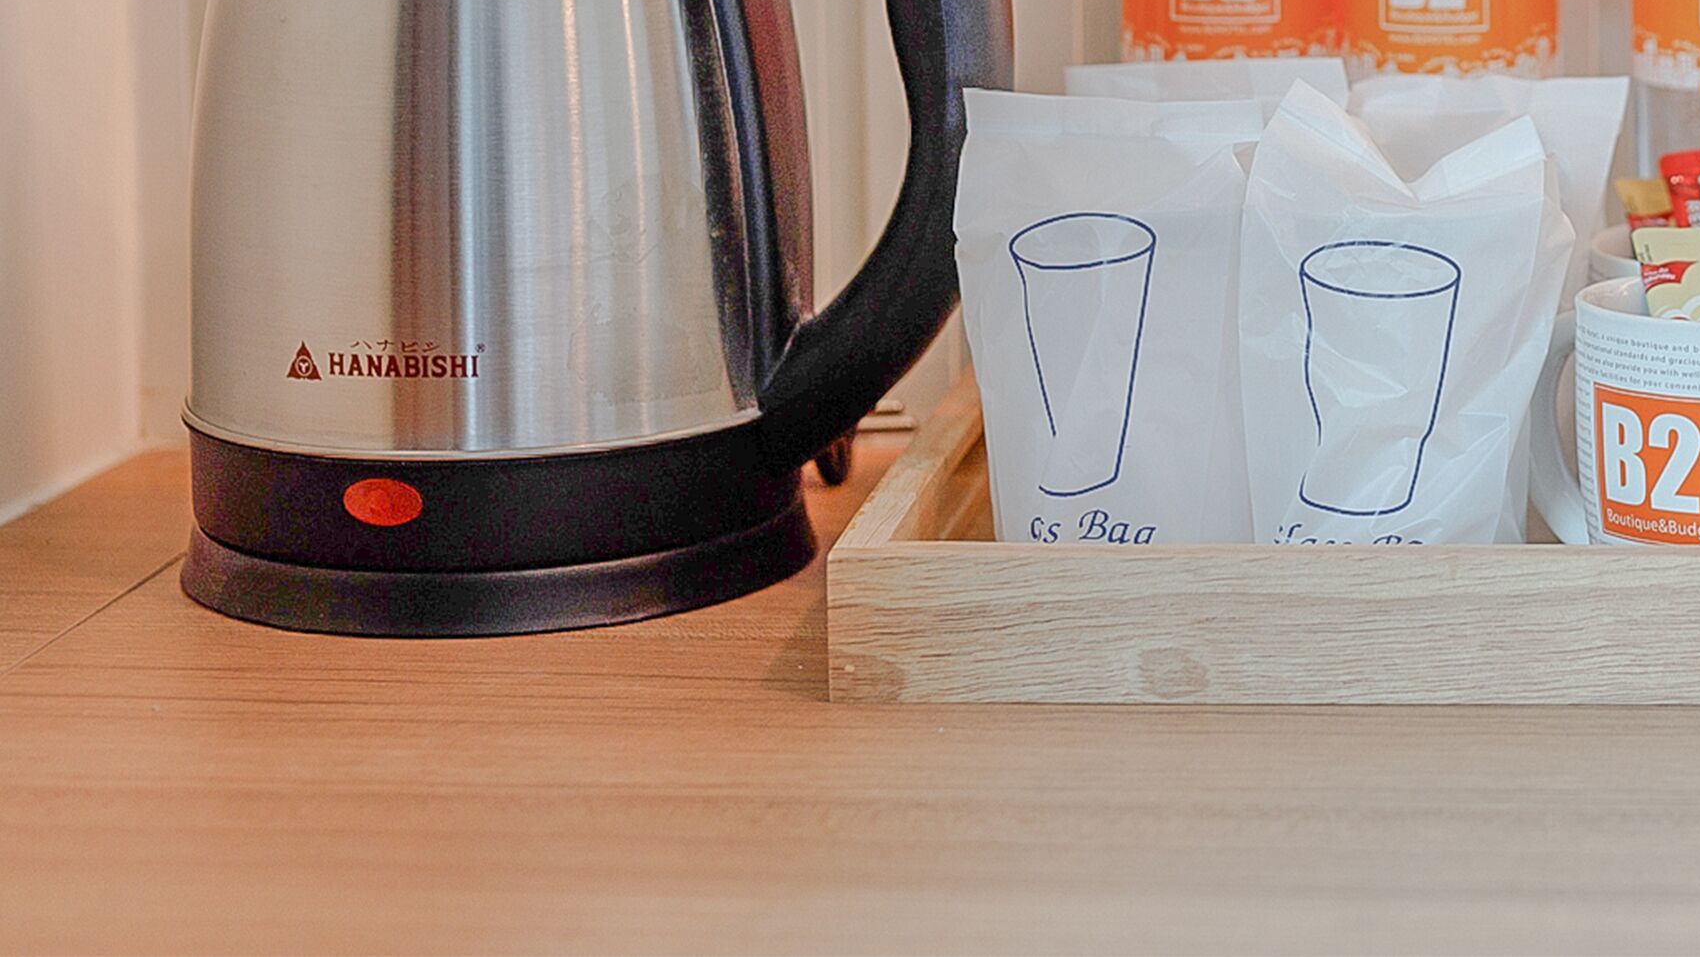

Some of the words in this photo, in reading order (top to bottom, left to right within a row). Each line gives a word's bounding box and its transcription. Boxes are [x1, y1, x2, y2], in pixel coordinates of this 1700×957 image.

[1631, 338, 1668, 351] boutique
[1672, 344, 1689, 353] and
[1614, 348, 1648, 361] standards
[1651, 353, 1666, 363] and
[329, 352, 479, 378] HANABISHI
[1660, 368, 1678, 377] with
